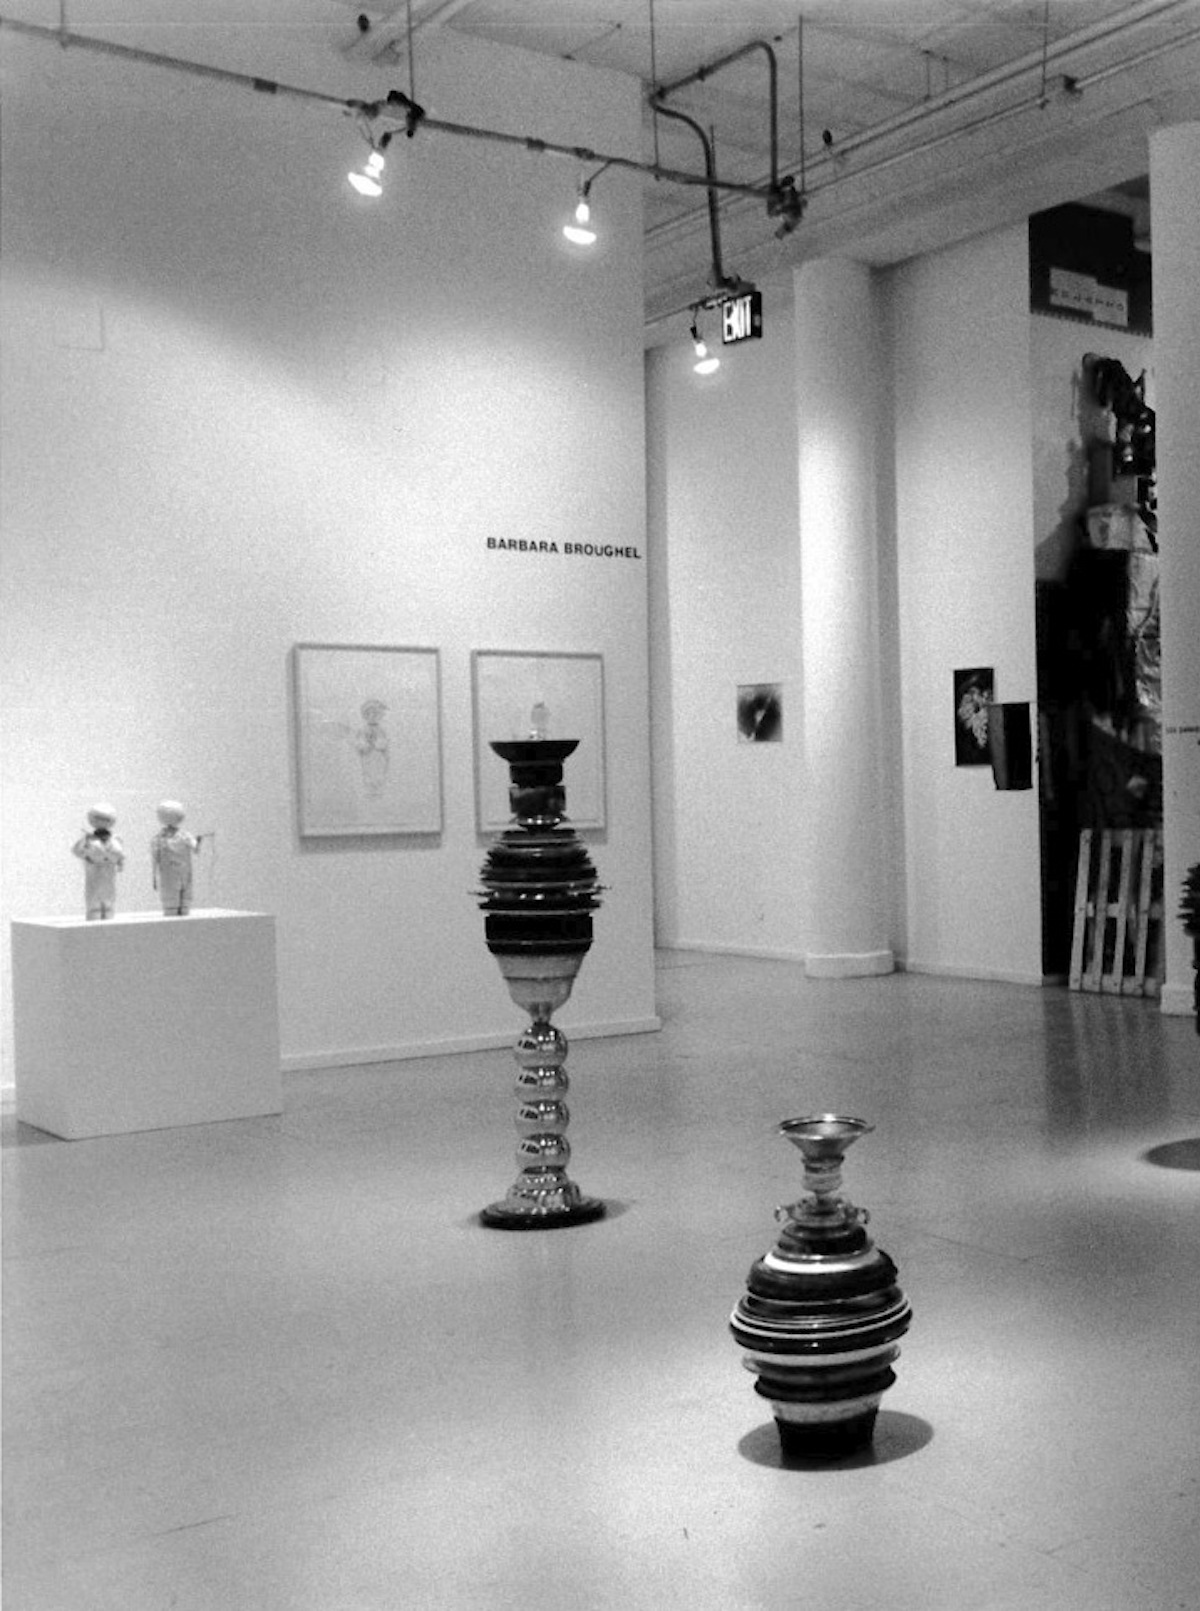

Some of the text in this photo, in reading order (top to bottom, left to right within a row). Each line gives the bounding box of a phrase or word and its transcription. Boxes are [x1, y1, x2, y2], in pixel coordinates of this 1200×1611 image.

[723, 296, 752, 342] EXIT
[487, 537, 642, 559] BARBARA BROUGHEL
